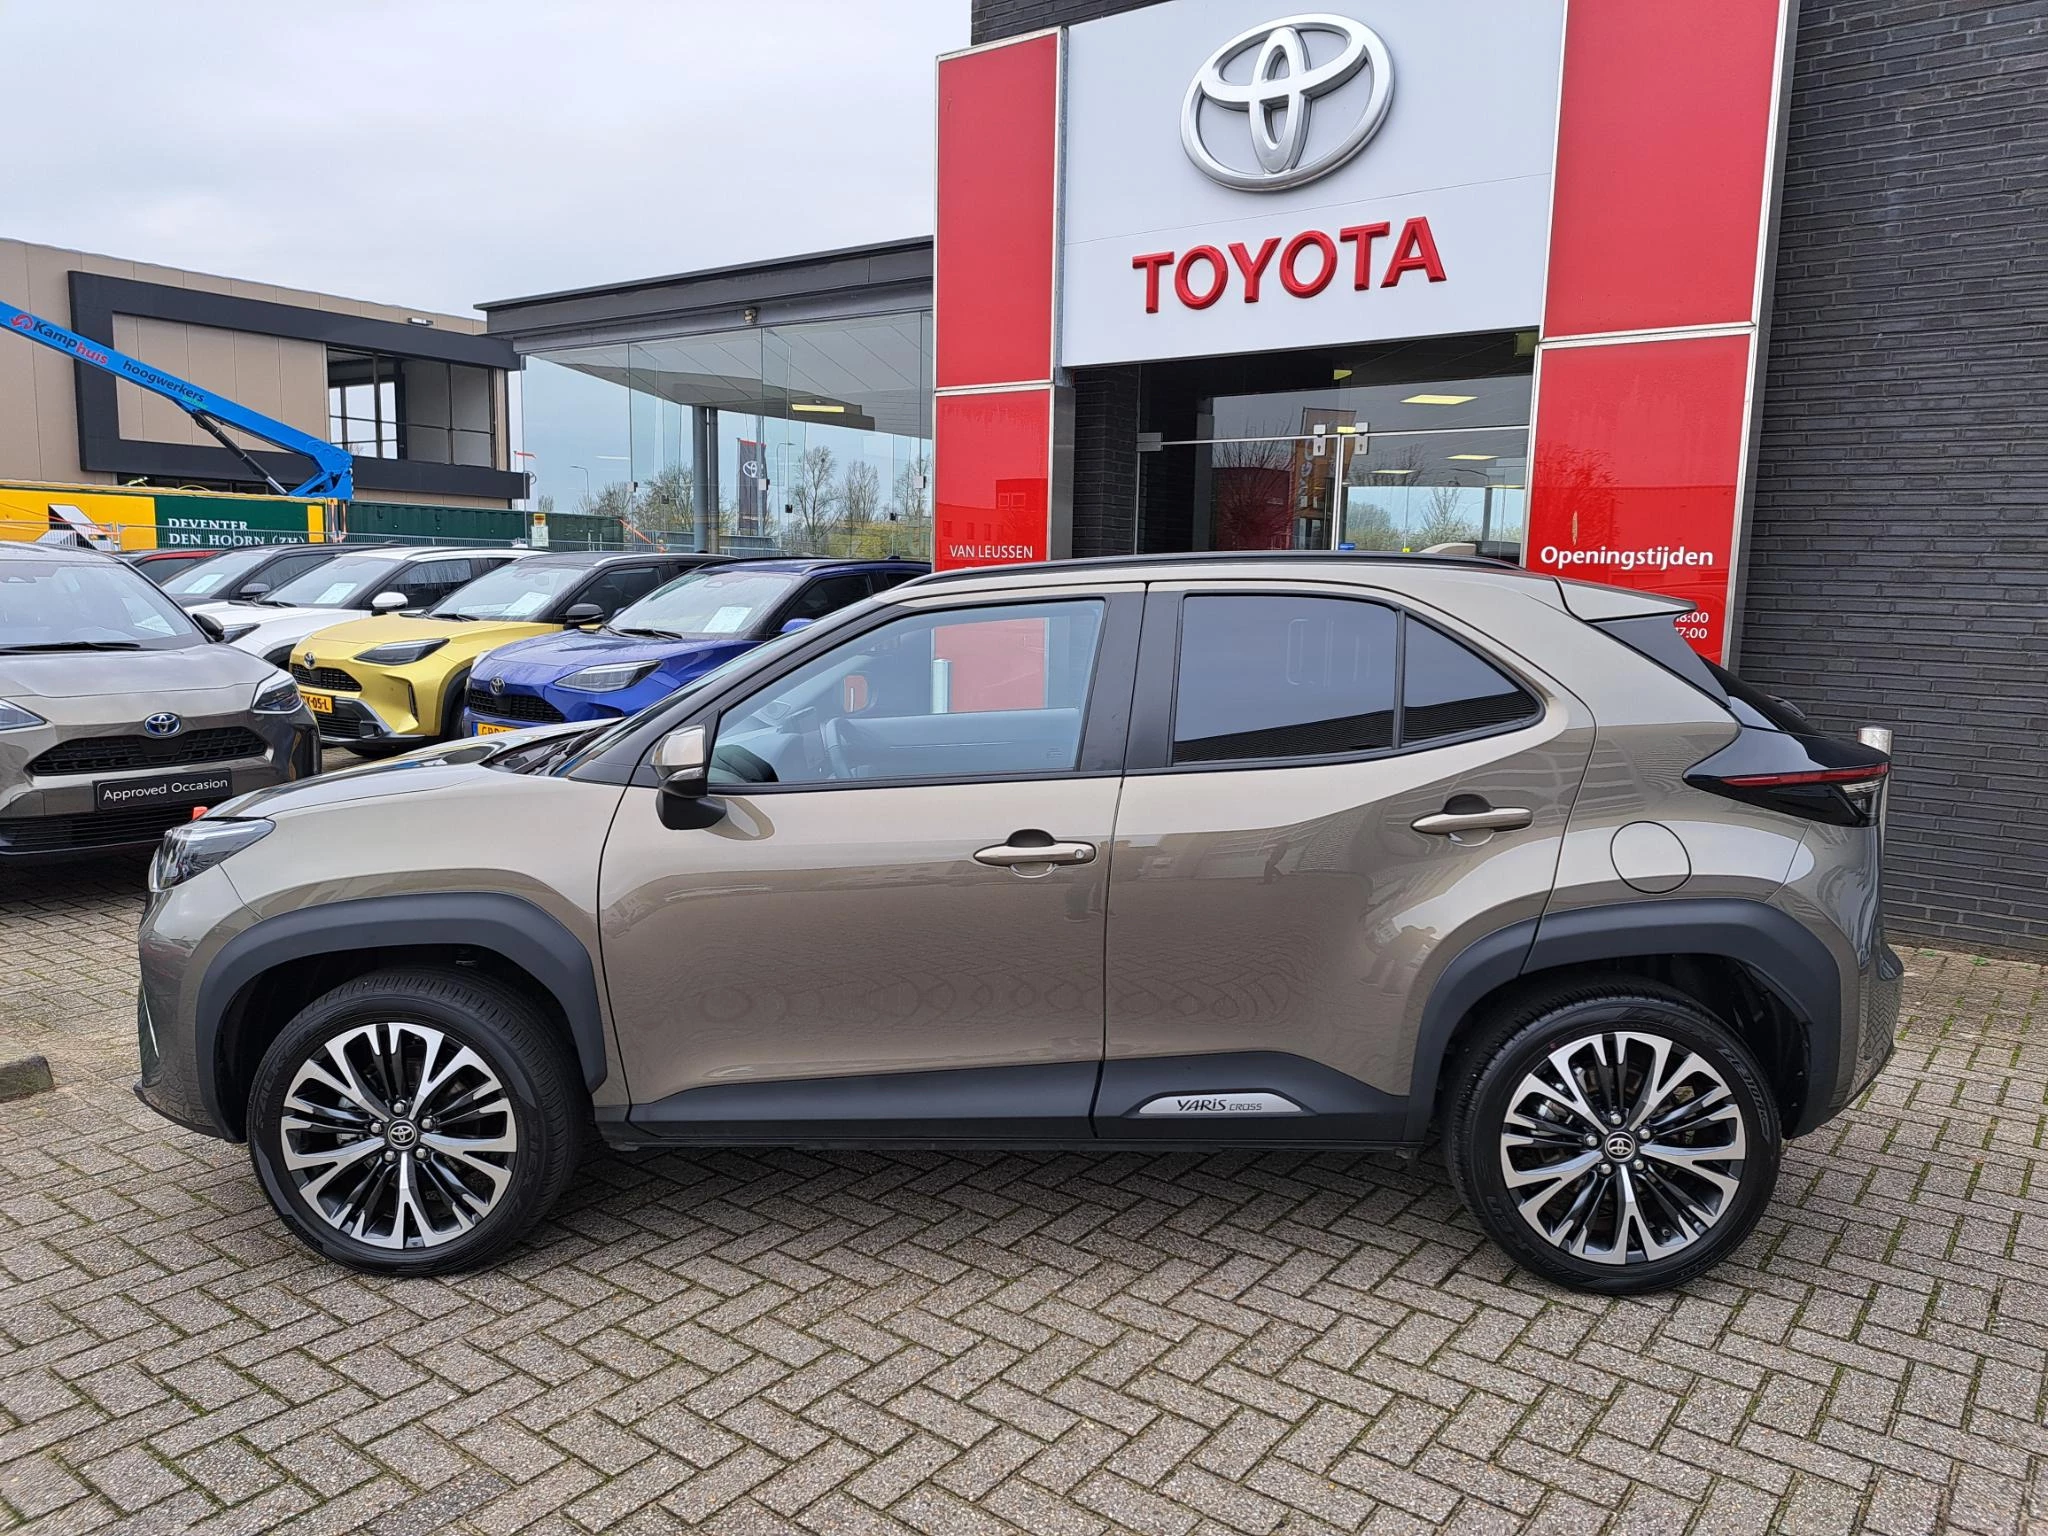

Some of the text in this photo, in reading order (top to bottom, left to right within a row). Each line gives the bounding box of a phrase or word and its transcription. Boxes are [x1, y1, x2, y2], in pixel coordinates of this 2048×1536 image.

[1132, 216, 1447, 314] TOYOTA
[33, 320, 205, 403] Kamphuis hoogwerkers
[168, 518, 248, 531] DEVENTER
[169, 533, 201, 545] DEN
[209, 535, 265, 547] HOORN
[949, 545, 1033, 559] VAN LEUSSEN
[1540, 546, 1714, 571] Openingstijden
[1675, 611, 1709, 623] 8:00
[103, 779, 228, 802] Approved Occasion
[1229, 1103, 1262, 1111] CROSS
